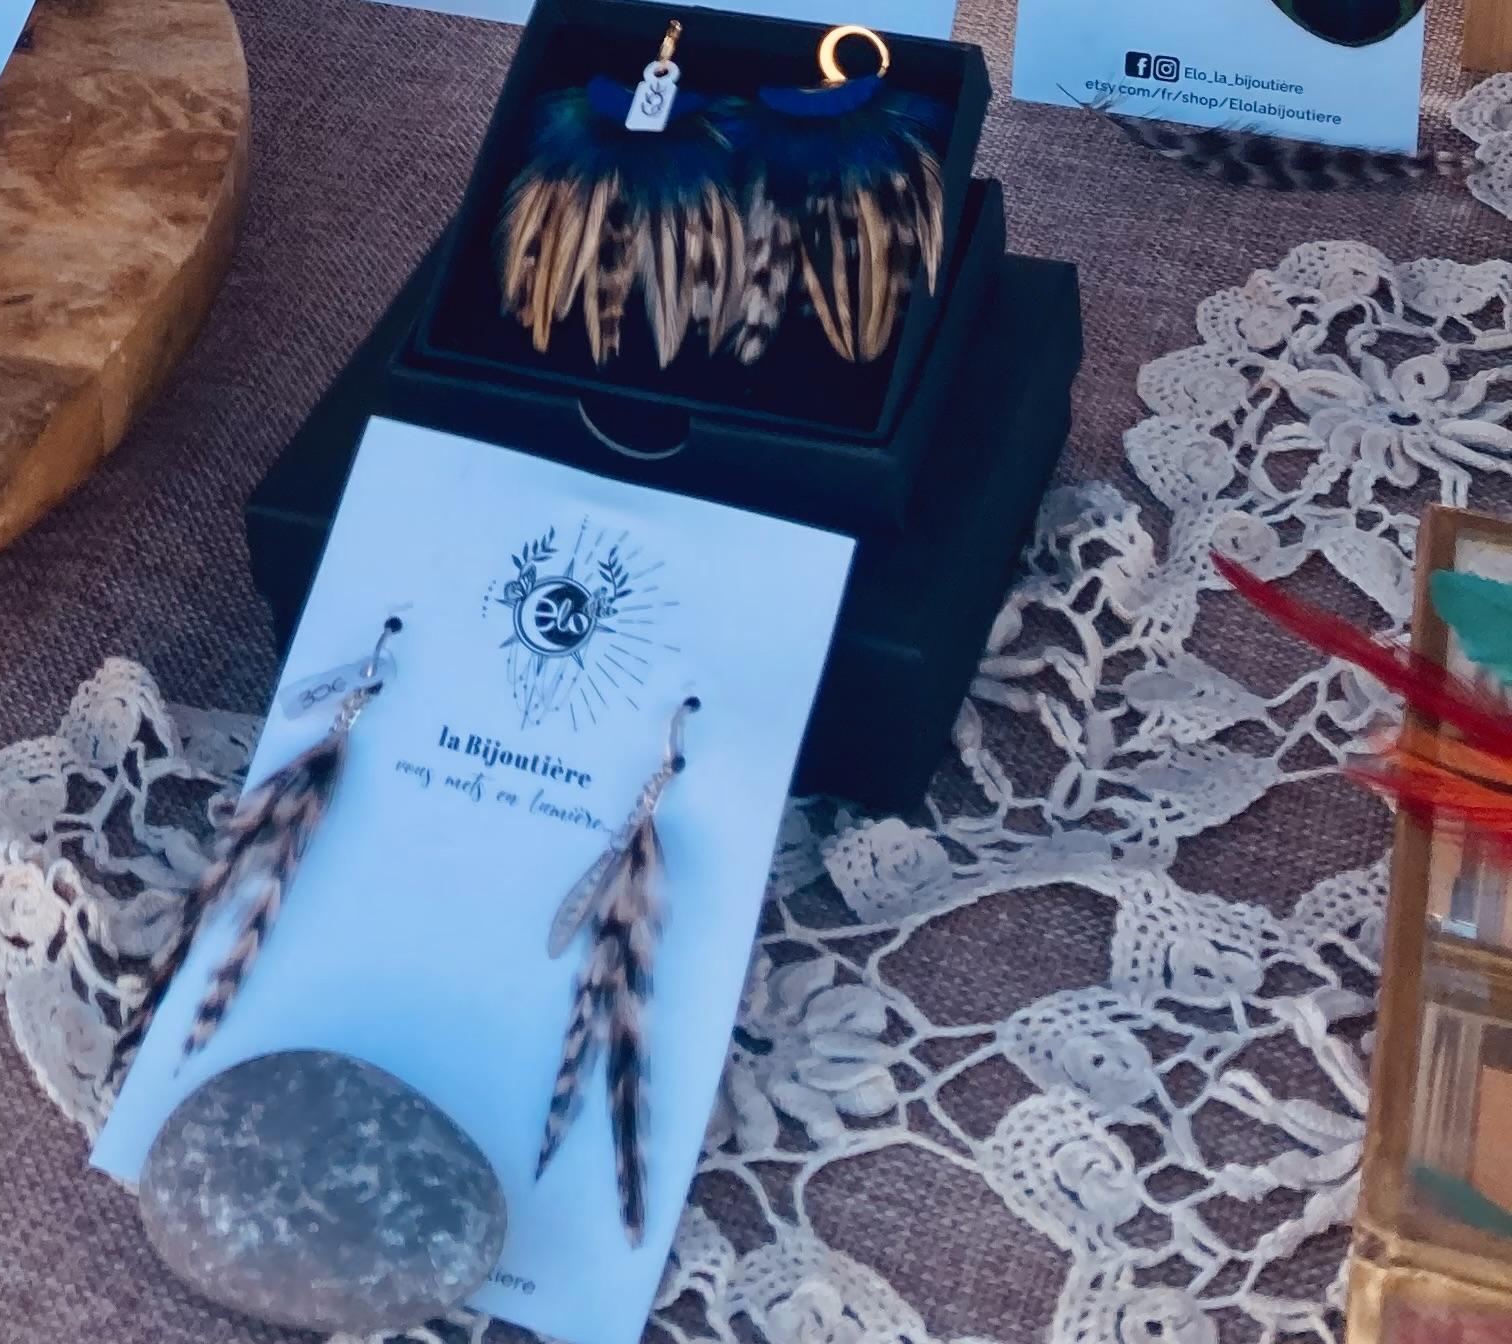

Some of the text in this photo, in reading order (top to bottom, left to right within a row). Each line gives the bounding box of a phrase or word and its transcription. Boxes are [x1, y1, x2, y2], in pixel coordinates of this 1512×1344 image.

[1183, 66, 1304, 95] Elo_la_bijoutière
[438, 724, 592, 789] la Bijoutière
